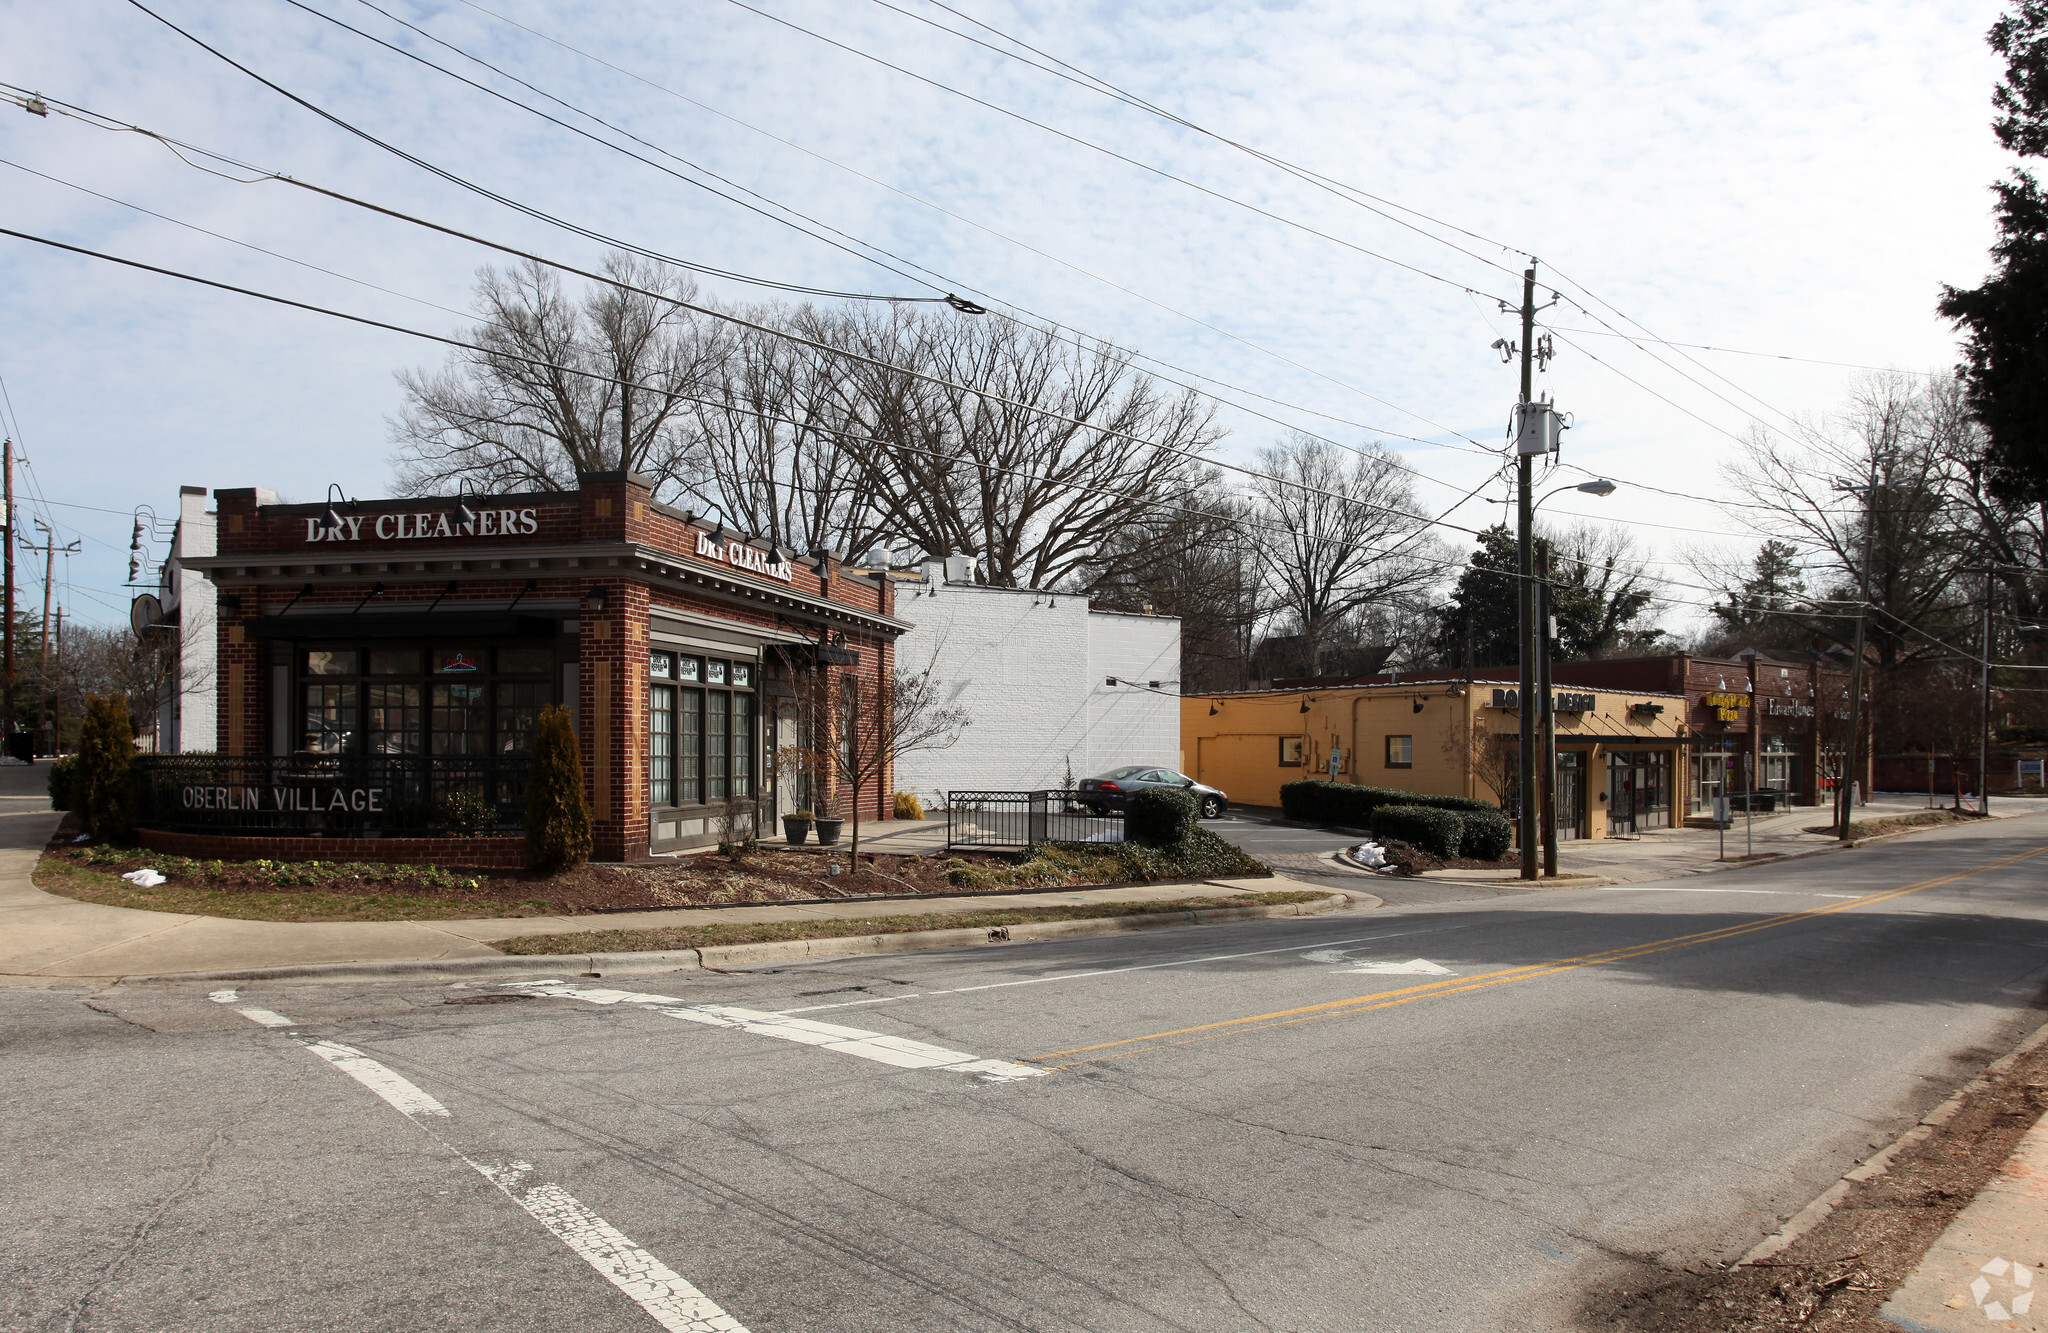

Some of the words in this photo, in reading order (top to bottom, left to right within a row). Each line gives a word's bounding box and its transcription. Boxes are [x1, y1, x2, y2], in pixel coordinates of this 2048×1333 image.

[305, 516, 366, 543] DRY
[375, 508, 539, 541] CLEANERS
[729, 542, 793, 582] CLEANERS
[1557, 692, 1595, 711] DESIGN
[1718, 708, 1738, 721] Pizza
[182, 786, 259, 810] OBERLIN
[273, 787, 384, 812] VILLAGE
